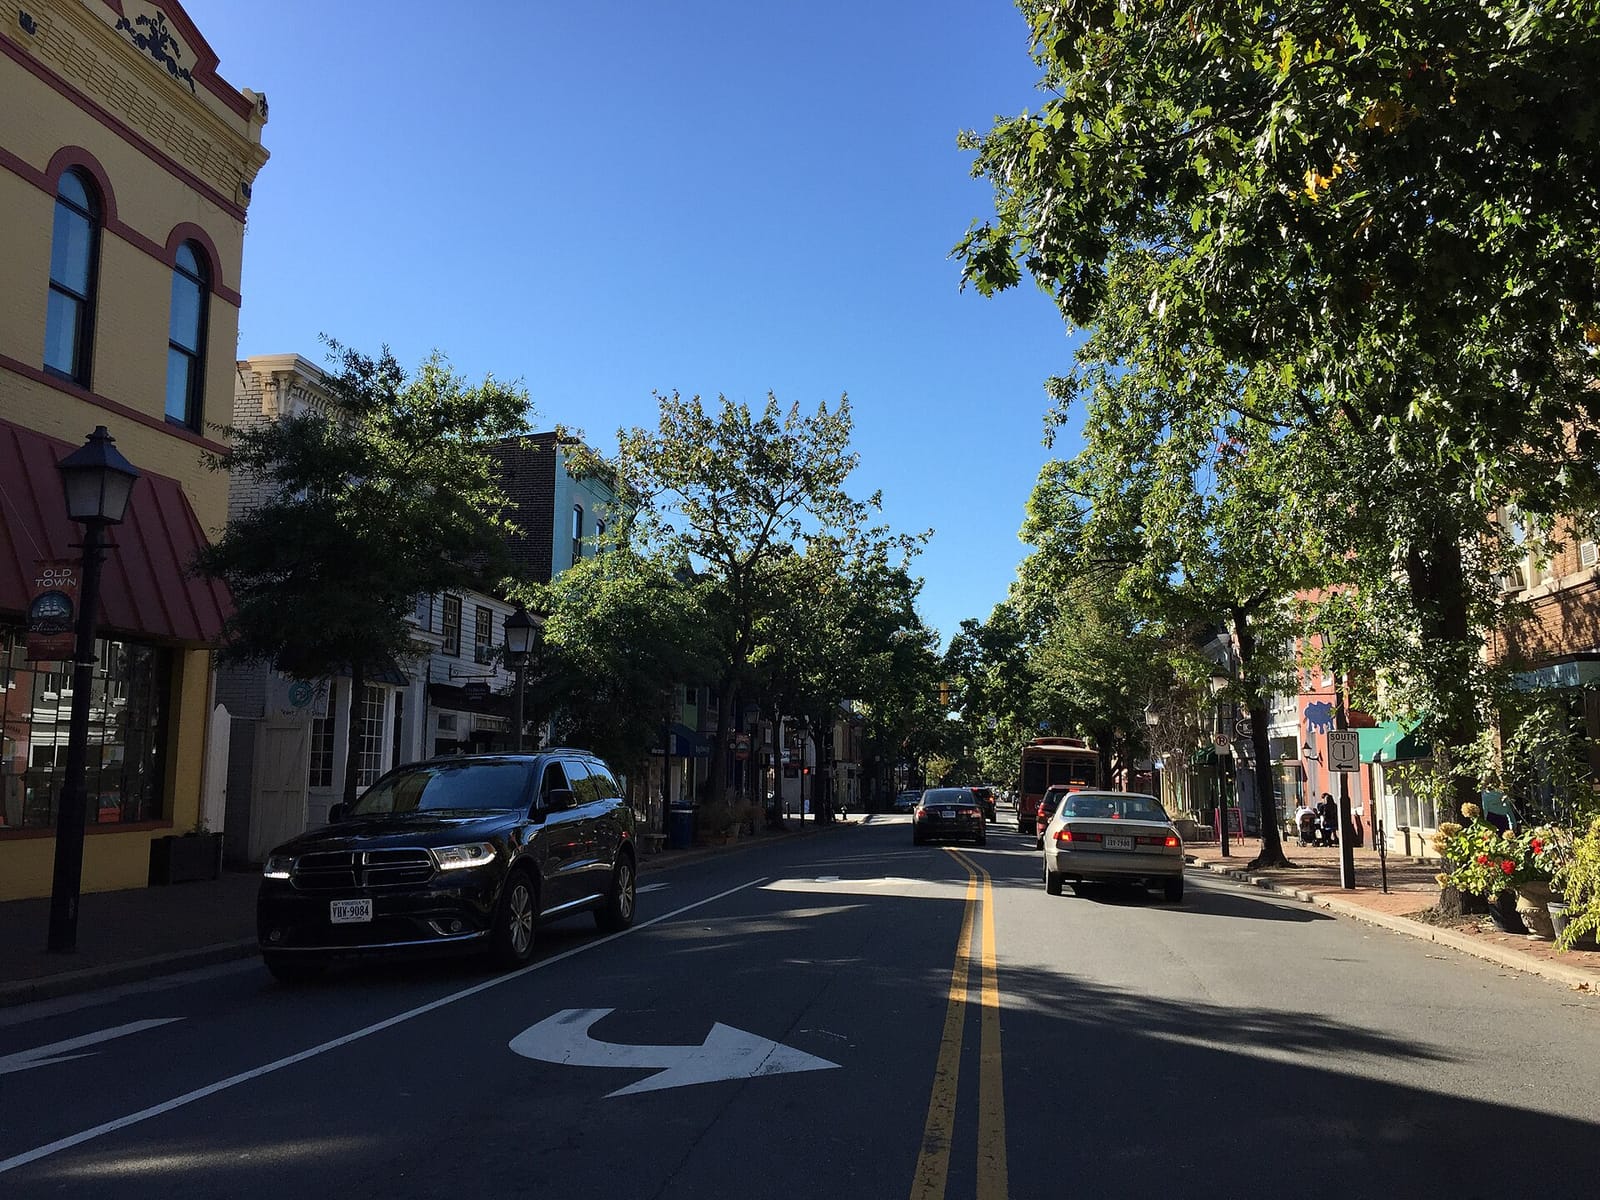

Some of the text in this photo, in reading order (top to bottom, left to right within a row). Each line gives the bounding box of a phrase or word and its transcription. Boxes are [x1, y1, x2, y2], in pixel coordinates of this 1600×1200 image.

[43, 568, 72, 578] OLD
[35, 577, 77, 588] TOWN
[1330, 733, 1357, 741] SOUTH
